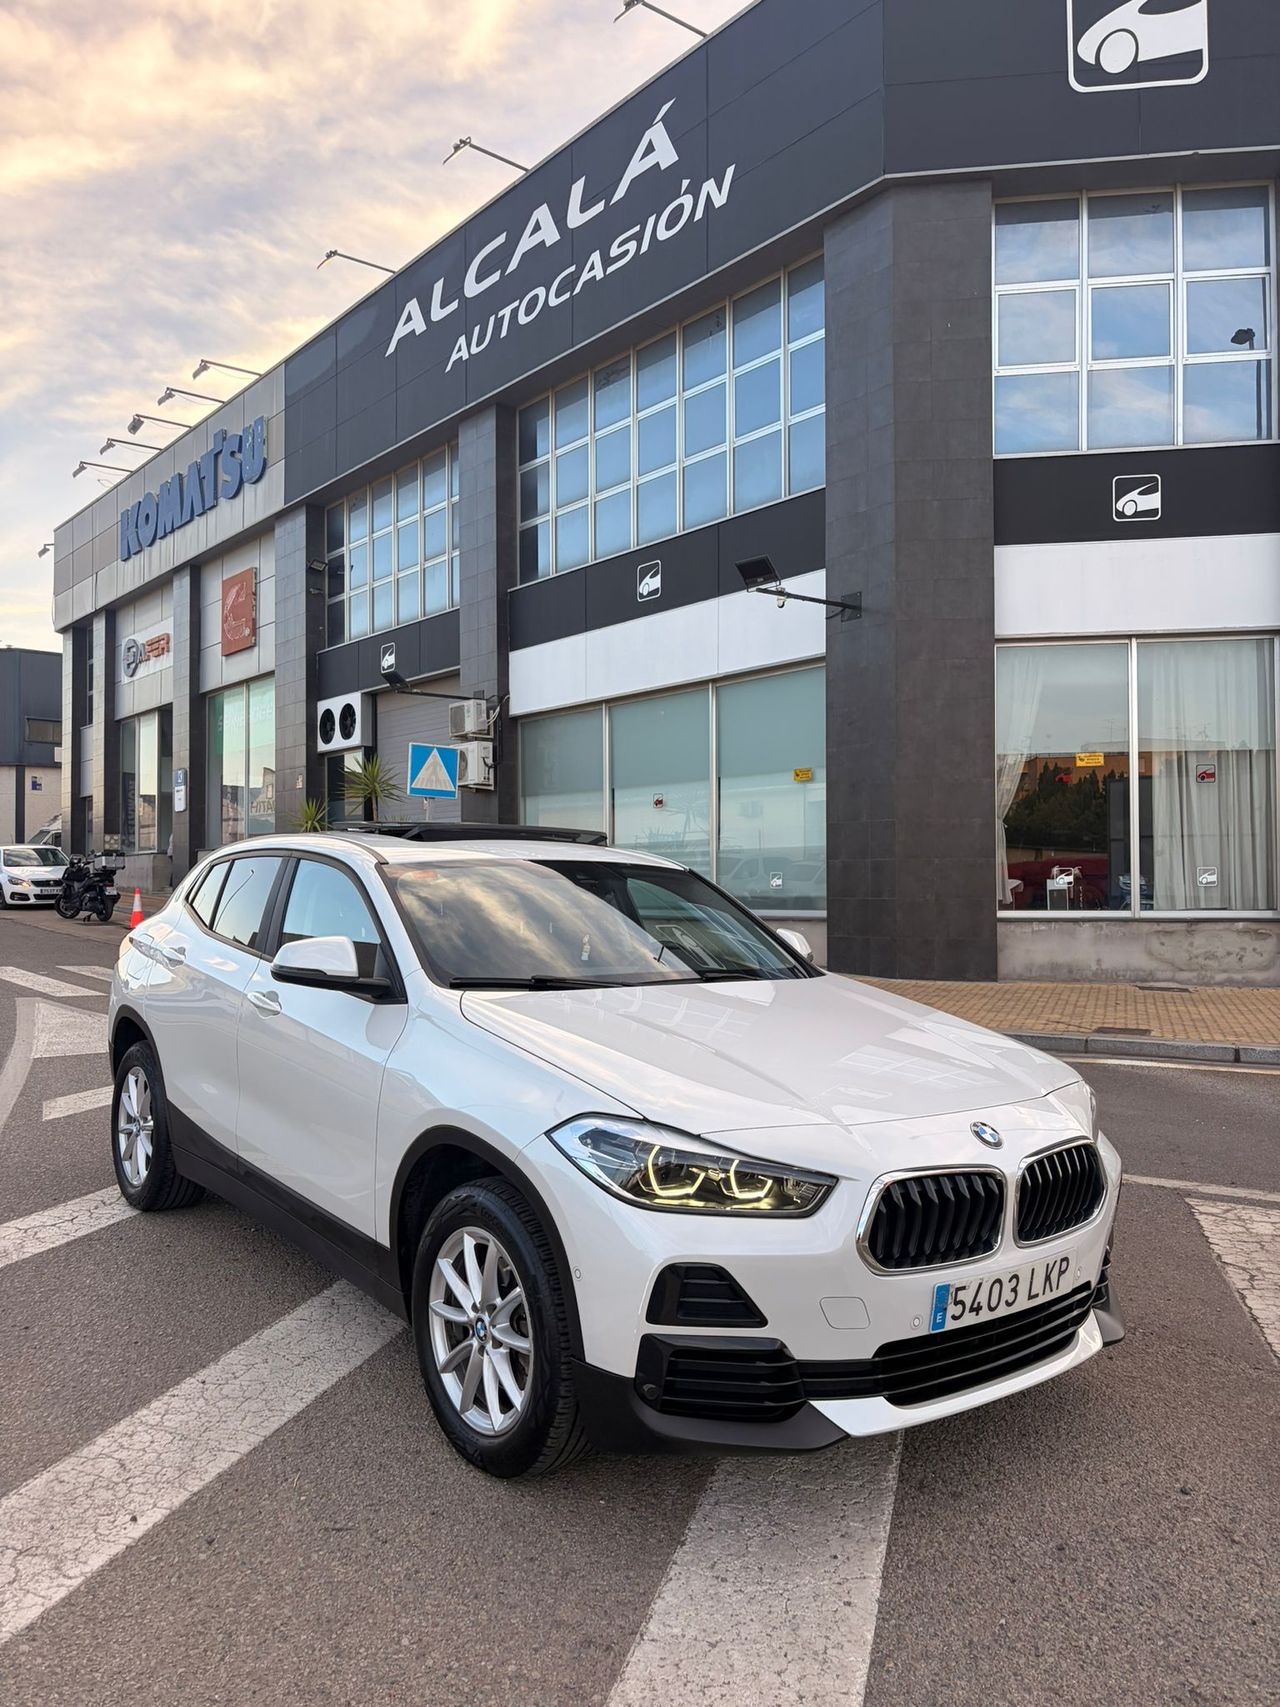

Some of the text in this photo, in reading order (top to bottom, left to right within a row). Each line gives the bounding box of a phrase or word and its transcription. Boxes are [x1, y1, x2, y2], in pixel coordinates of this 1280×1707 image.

[384, 97, 679, 358] ALCALÁ
[445, 163, 736, 374] AUTOCASIÓN
[120, 415, 267, 562] KOMATSU
[950, 1256, 1070, 1321] 5403 LKP
